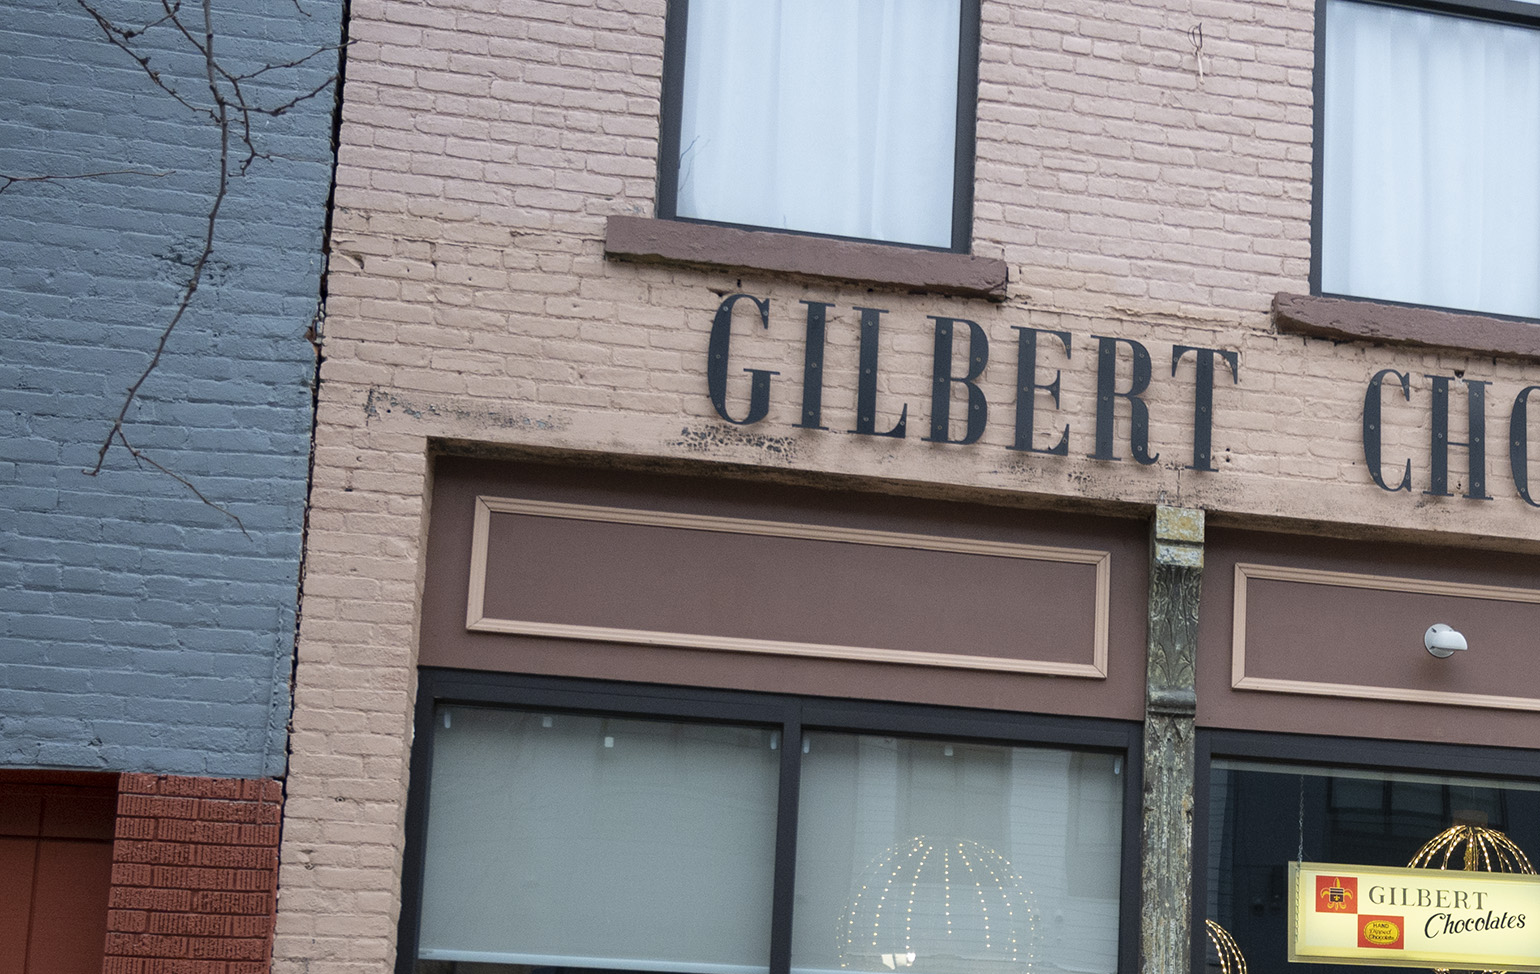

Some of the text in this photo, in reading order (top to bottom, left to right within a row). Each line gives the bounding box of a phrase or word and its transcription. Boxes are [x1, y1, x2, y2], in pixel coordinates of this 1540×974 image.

[707, 293, 1239, 472] GILBERT
[1368, 885, 1488, 910] GILBERT
[1424, 910, 1526, 939] Chocolates
